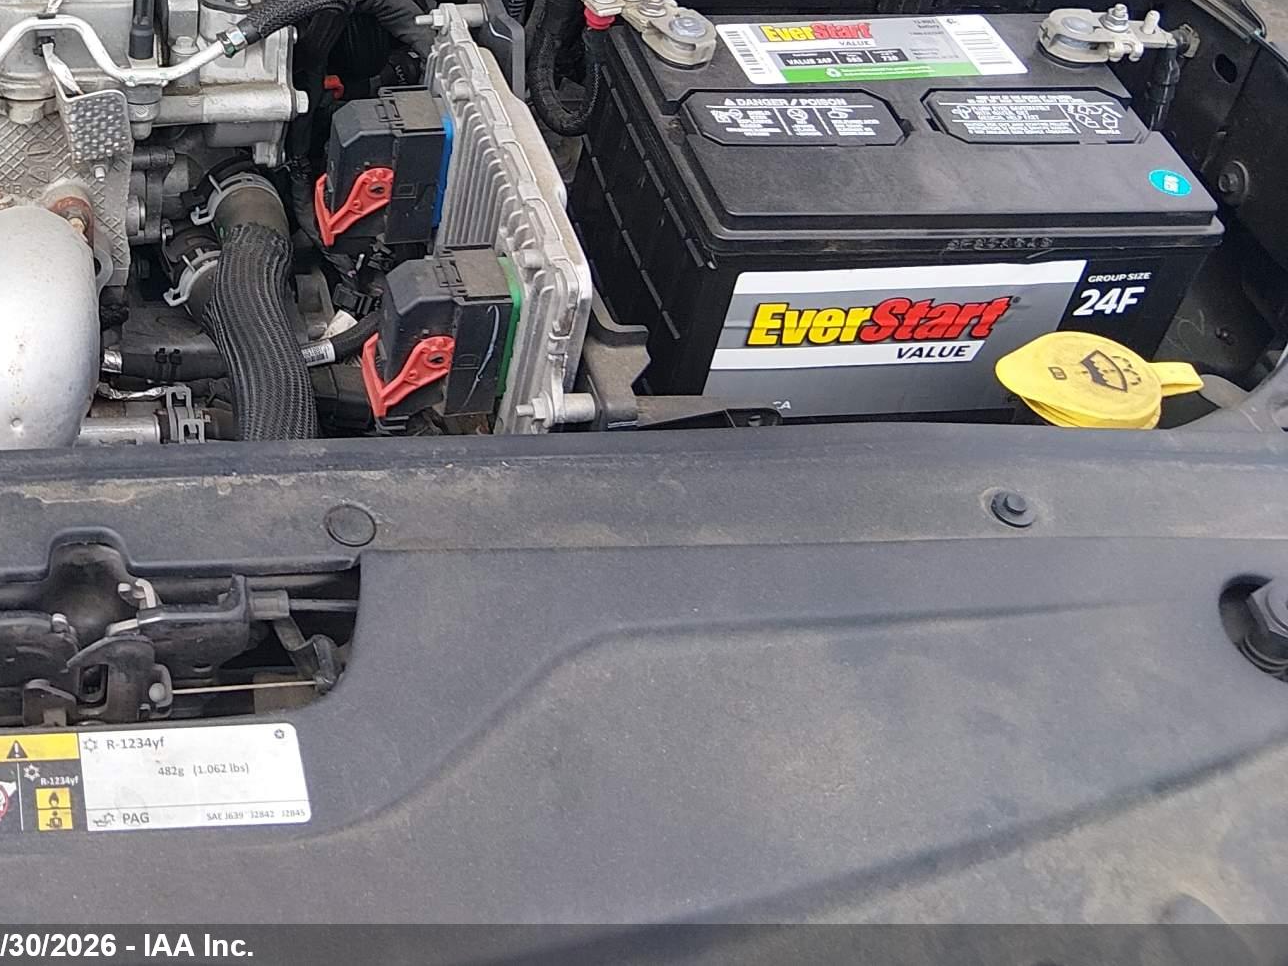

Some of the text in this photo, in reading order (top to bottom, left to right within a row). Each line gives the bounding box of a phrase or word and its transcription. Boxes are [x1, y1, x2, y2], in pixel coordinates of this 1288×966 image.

[759, 22, 872, 42] EverStart
[735, 98, 789, 106] DANGER
[798, 98, 848, 106] POISON
[1088, 272, 1152, 283] GROUP SIZE
[1072, 286, 1146, 316] 24F
[746, 296, 1012, 346] EverStart
[896, 344, 972, 359] VALUE
[106, 737, 165, 752] R-1234yf
[158, 762, 250, 777] 482g (1.062 lbs)
[40, 775, 79, 786] R-1234yf
[122, 812, 150, 824] PAG
